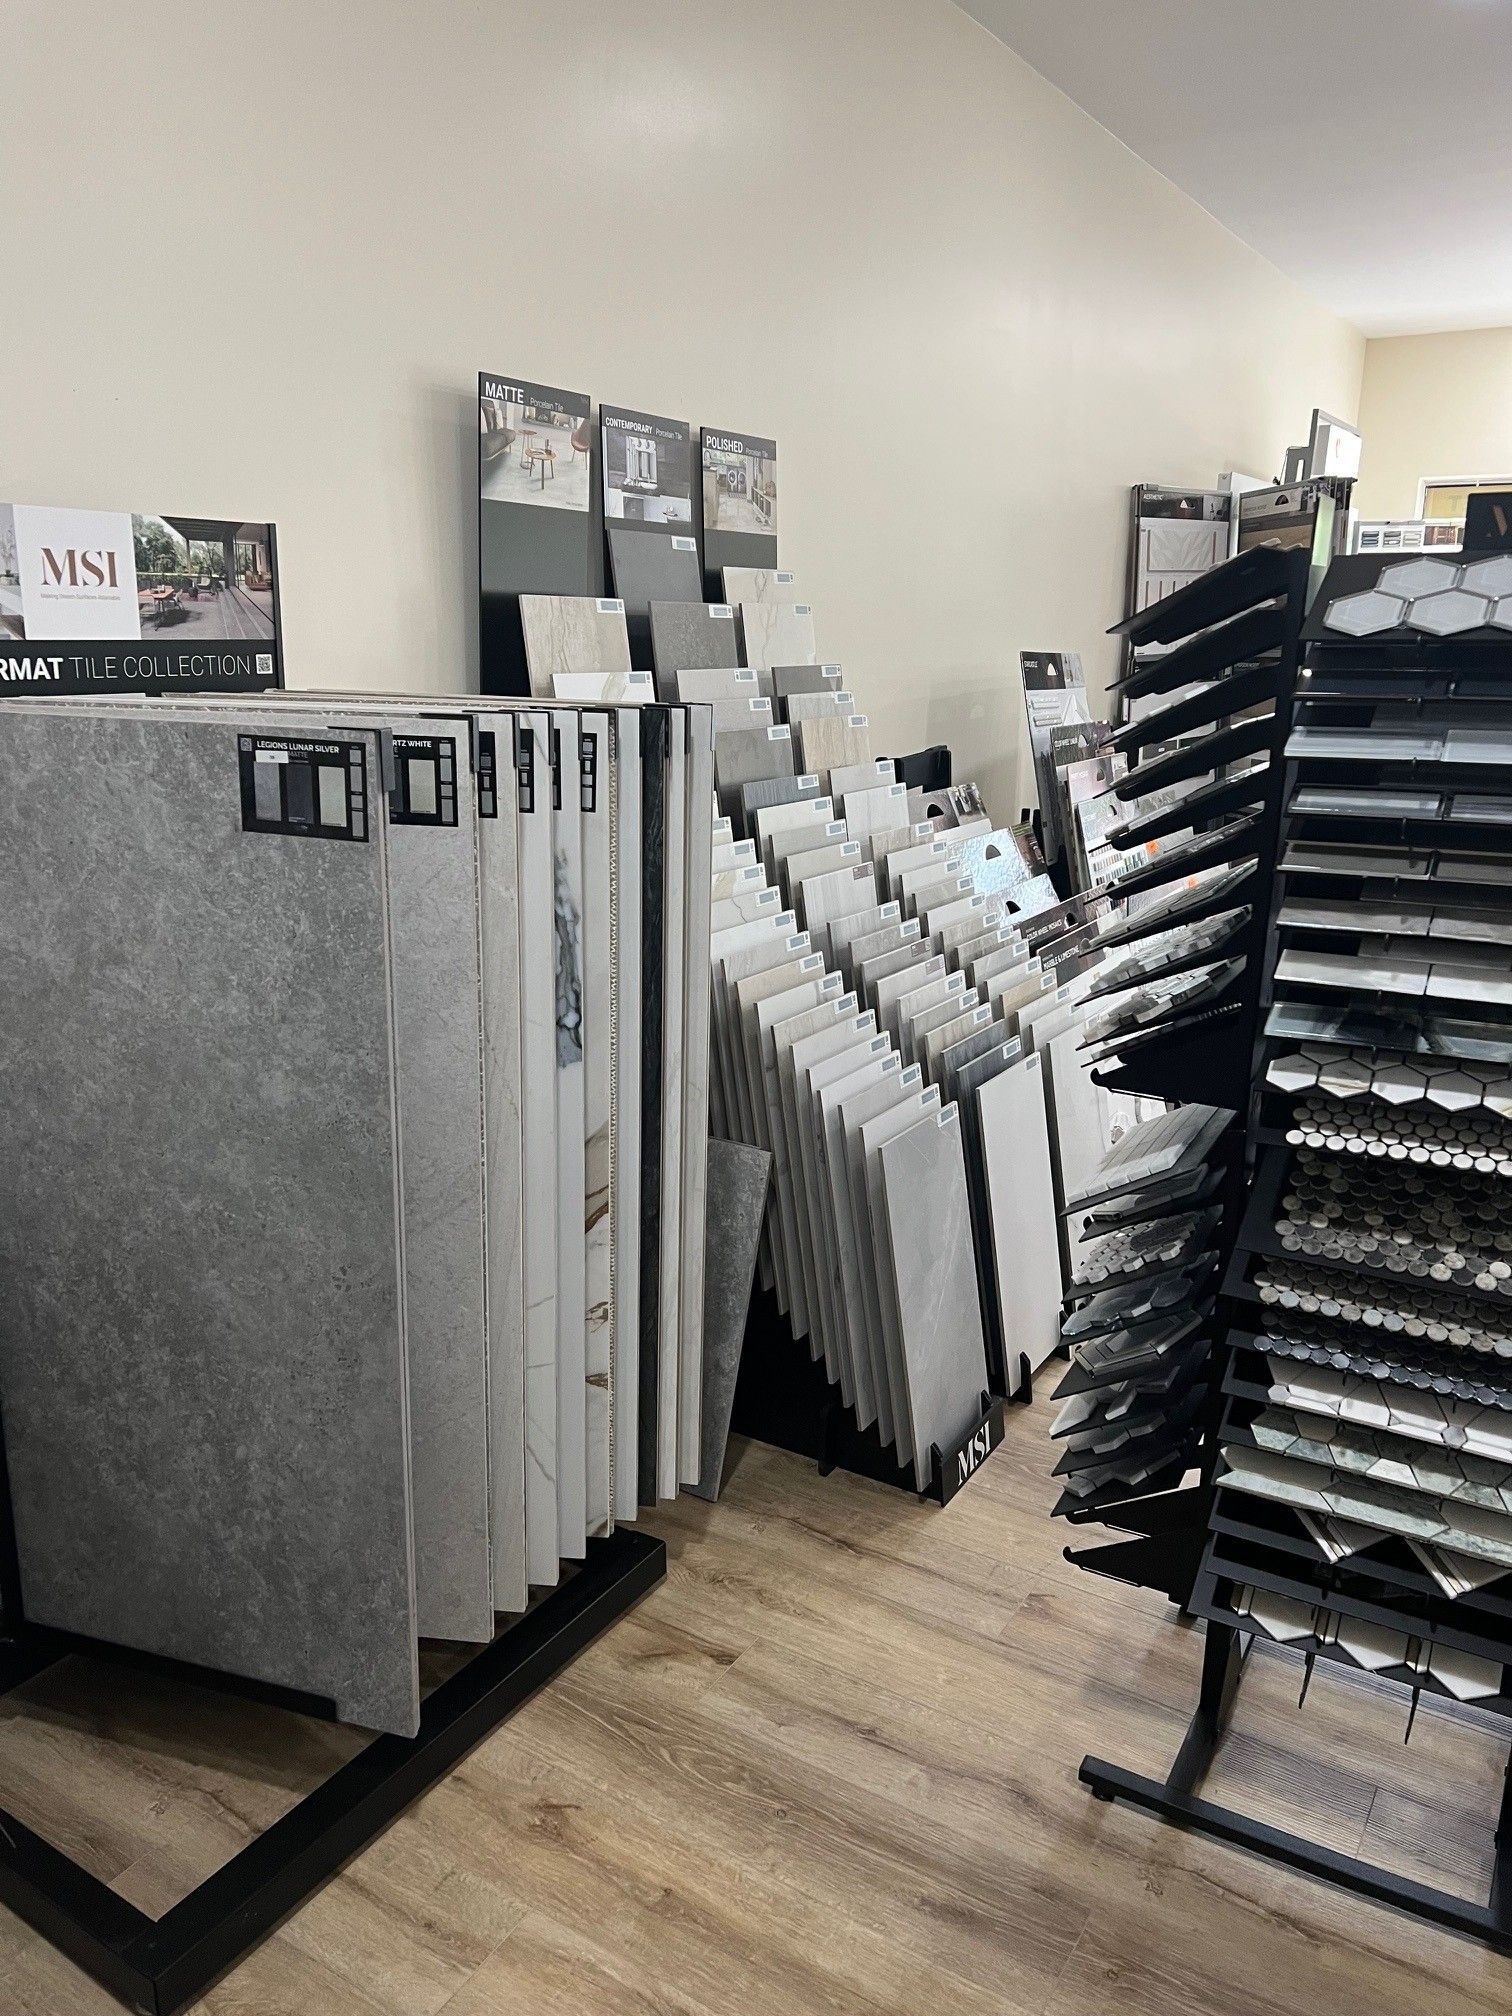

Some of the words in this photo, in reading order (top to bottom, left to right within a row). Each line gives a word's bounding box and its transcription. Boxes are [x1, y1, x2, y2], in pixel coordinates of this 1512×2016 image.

[485, 381, 525, 404] MATTE
[530, 397, 554, 410] Porcelain
[554, 402, 564, 412] Tile
[605, 416, 653, 434] CONTEMPORARY
[706, 435, 743, 453] POLISHED
[41, 547, 118, 587] MSI
[0, 657, 64, 681] RMAT
[68, 656, 118, 679] TILE
[123, 654, 251, 678] COLLECTION
[256, 740, 288, 750] LEGIONS
[288, 742, 314, 752] LUNAR
[314, 744, 340, 754] SILVER
[407, 740, 432, 748] WHITE
[957, 1420, 991, 1487] MSI
